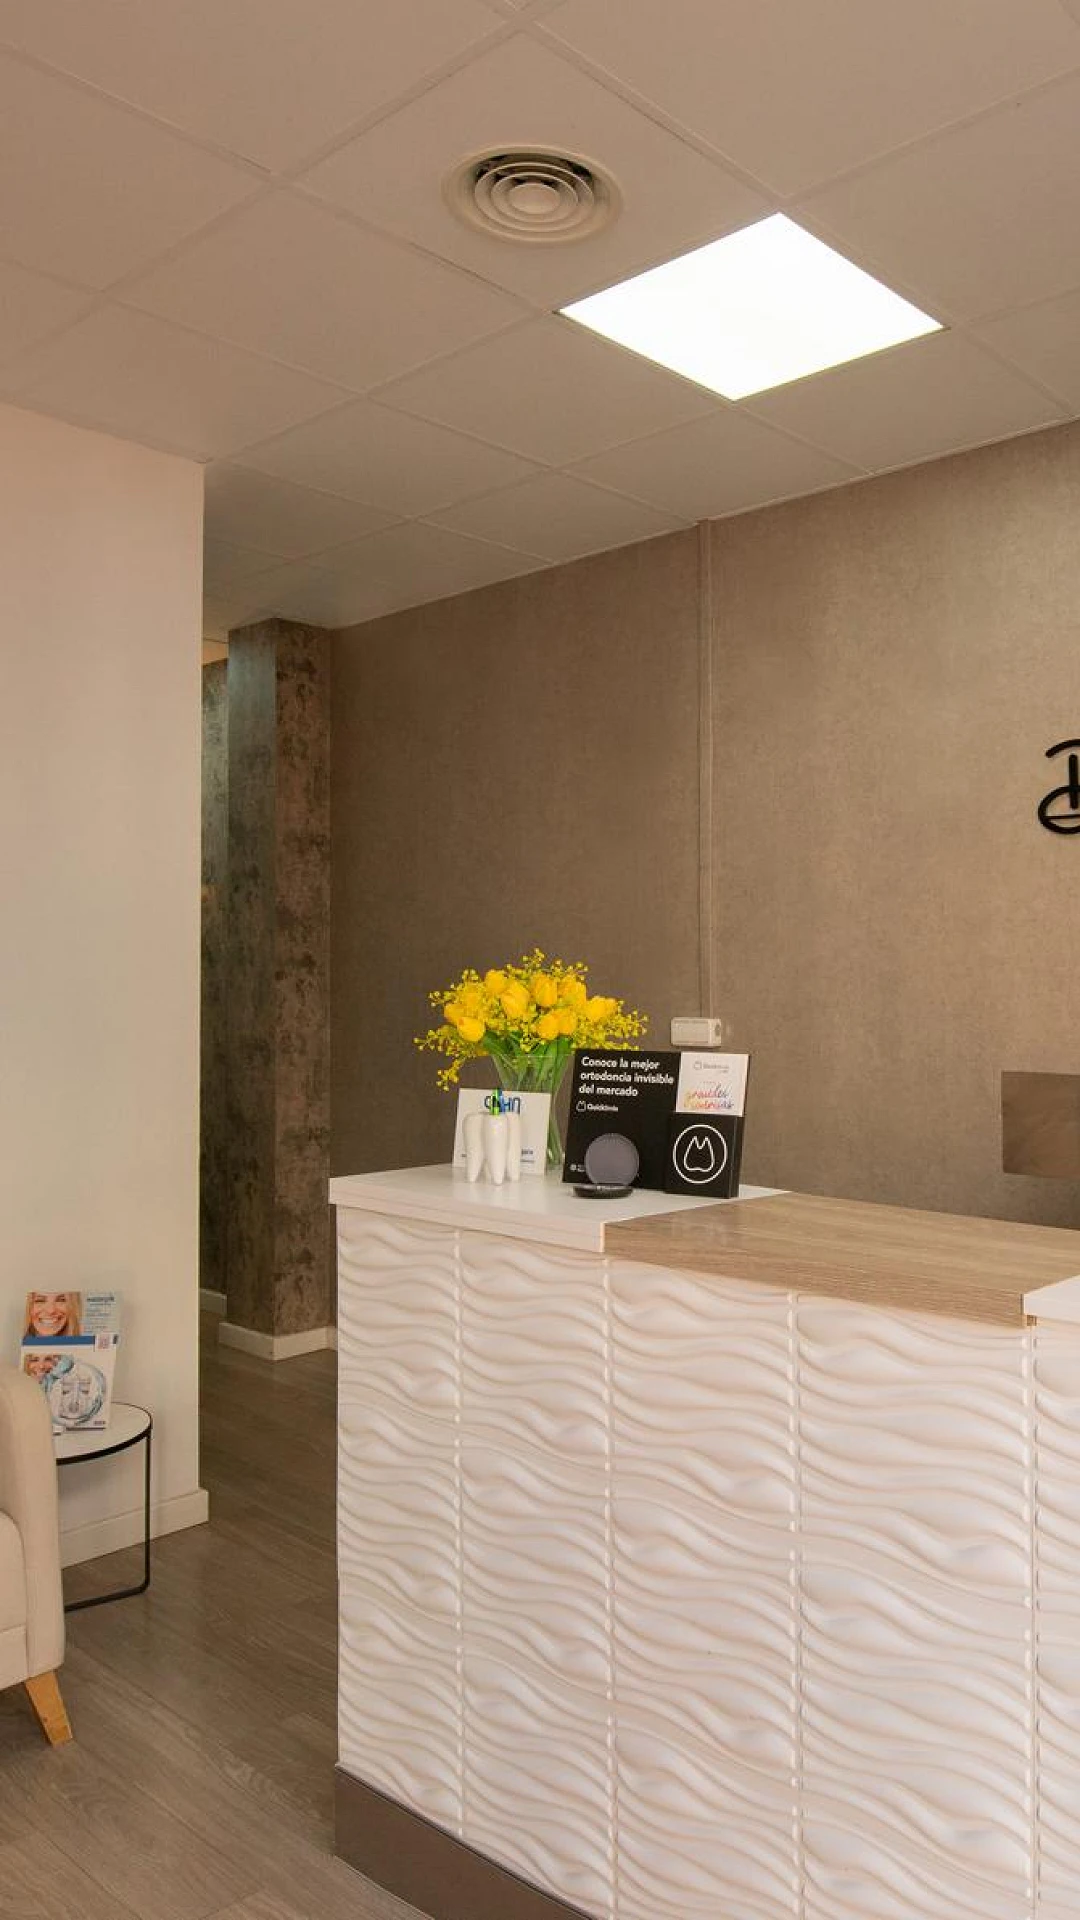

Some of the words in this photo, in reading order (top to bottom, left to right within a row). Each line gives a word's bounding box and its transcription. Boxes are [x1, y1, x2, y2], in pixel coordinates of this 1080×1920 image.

[581, 1056, 618, 1068] Conoce
[619, 1057, 629, 1068] la
[630, 1058, 660, 1072] mejor
[580, 1069, 632, 1083] ortodoncia
[633, 1071, 674, 1085] invisible
[578, 1083, 595, 1094] del
[596, 1085, 639, 1097] mercado
